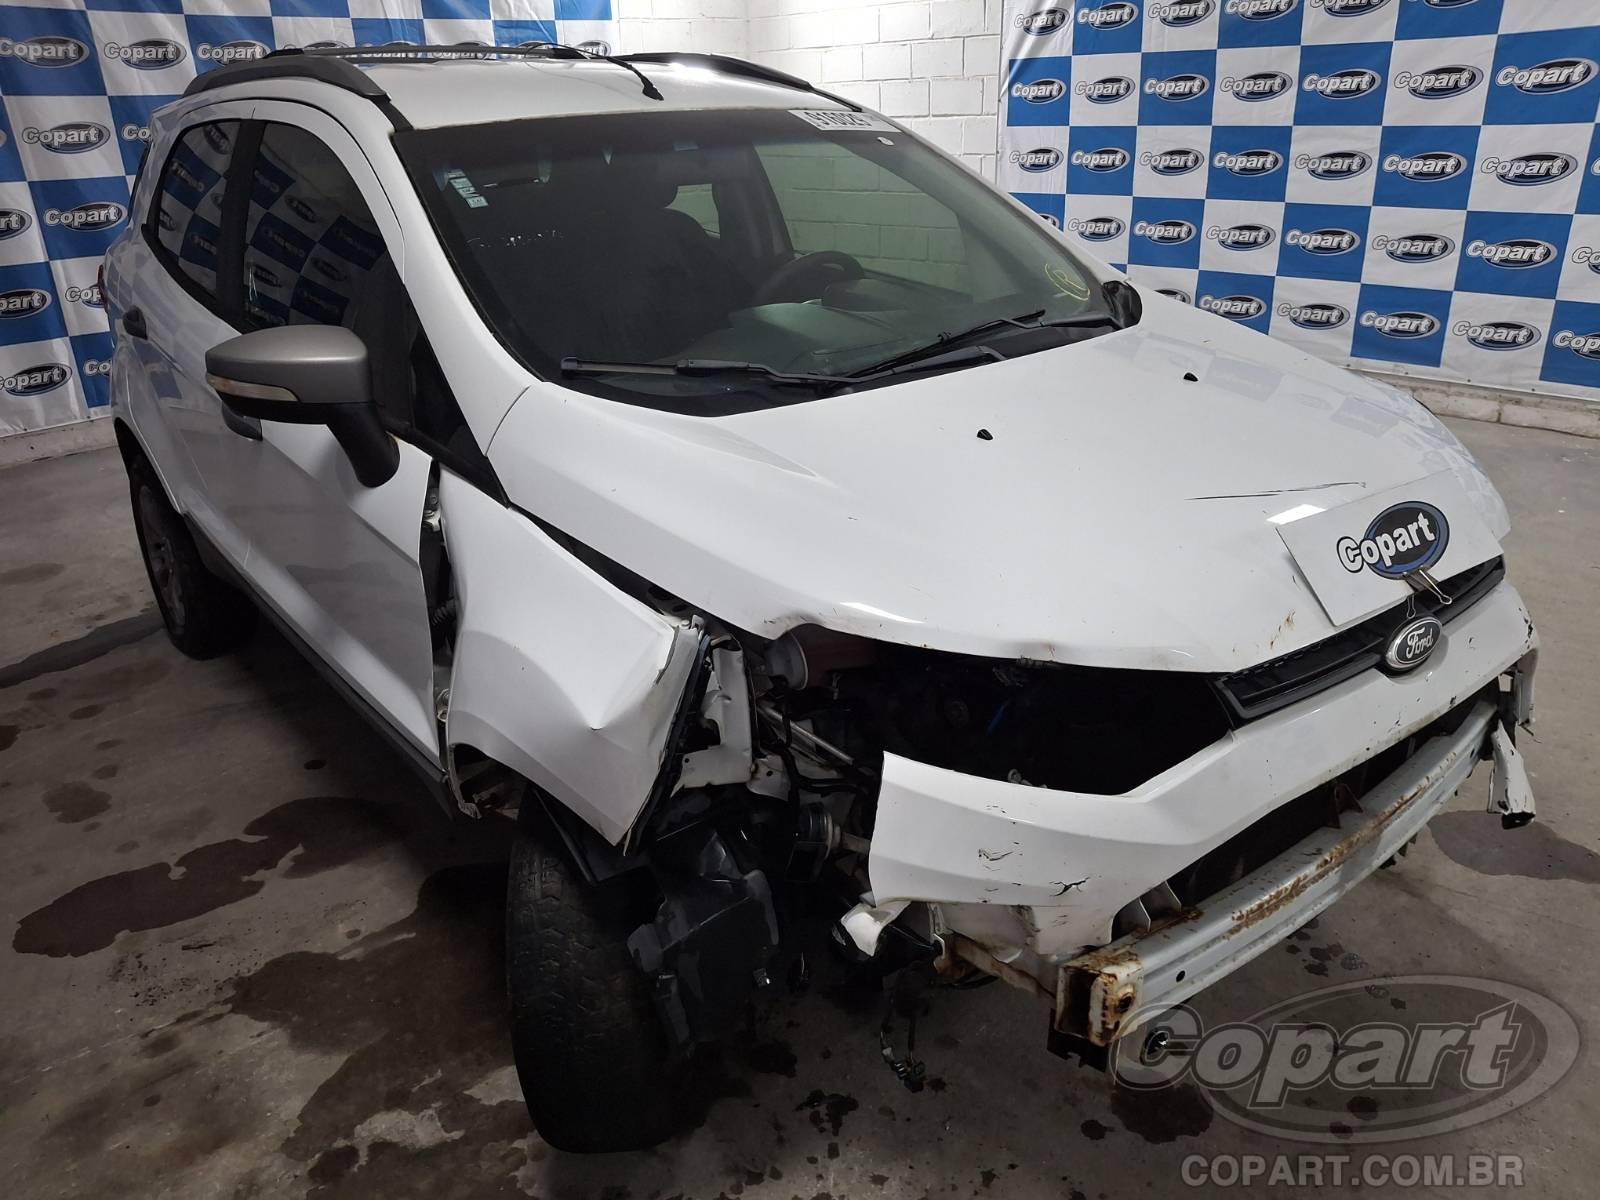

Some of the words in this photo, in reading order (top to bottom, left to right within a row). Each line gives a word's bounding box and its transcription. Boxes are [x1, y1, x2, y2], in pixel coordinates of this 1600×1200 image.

[1014, 12, 1063, 31] Copart
[1077, 4, 1132, 24] Copart
[1148, 0, 1206, 21] Copart
[0, 37, 78, 62] Copart
[103, 42, 178, 61] Copart
[197, 43, 264, 61] Copart
[1220, 74, 1284, 96] Copart
[1303, 71, 1373, 95] Copart
[1394, 70, 1471, 93] Copart
[1496, 62, 1588, 90] Copart
[1011, 82, 1061, 100] Copart
[1074, 80, 1128, 99] Copart
[1143, 78, 1202, 98] Copart
[22, 125, 100, 147] Copart
[1008, 149, 1058, 169] Copart
[1070, 149, 1124, 169] Copart
[1139, 150, 1197, 170] Copart
[1213, 151, 1276, 172] Copart
[1295, 153, 1363, 174] Copart
[1383, 154, 1458, 177] Copart
[1481, 155, 1567, 178] Copart
[44, 203, 120, 228] Copart
[1068, 217, 1120, 238] Copart
[1133, 219, 1190, 241] Copart
[1205, 225, 1268, 247] Copart
[1284, 228, 1354, 250] Copart
[1371, 234, 1446, 257] Copart
[1466, 240, 1548, 262] Copart
[1199, 294, 1260, 317] Copart
[1276, 302, 1344, 325] Copart
[1360, 310, 1434, 335] Copart
[1453, 320, 1530, 344] Copart
[1336, 511, 1436, 574] Copart
[1404, 626, 1435, 660] Ford
